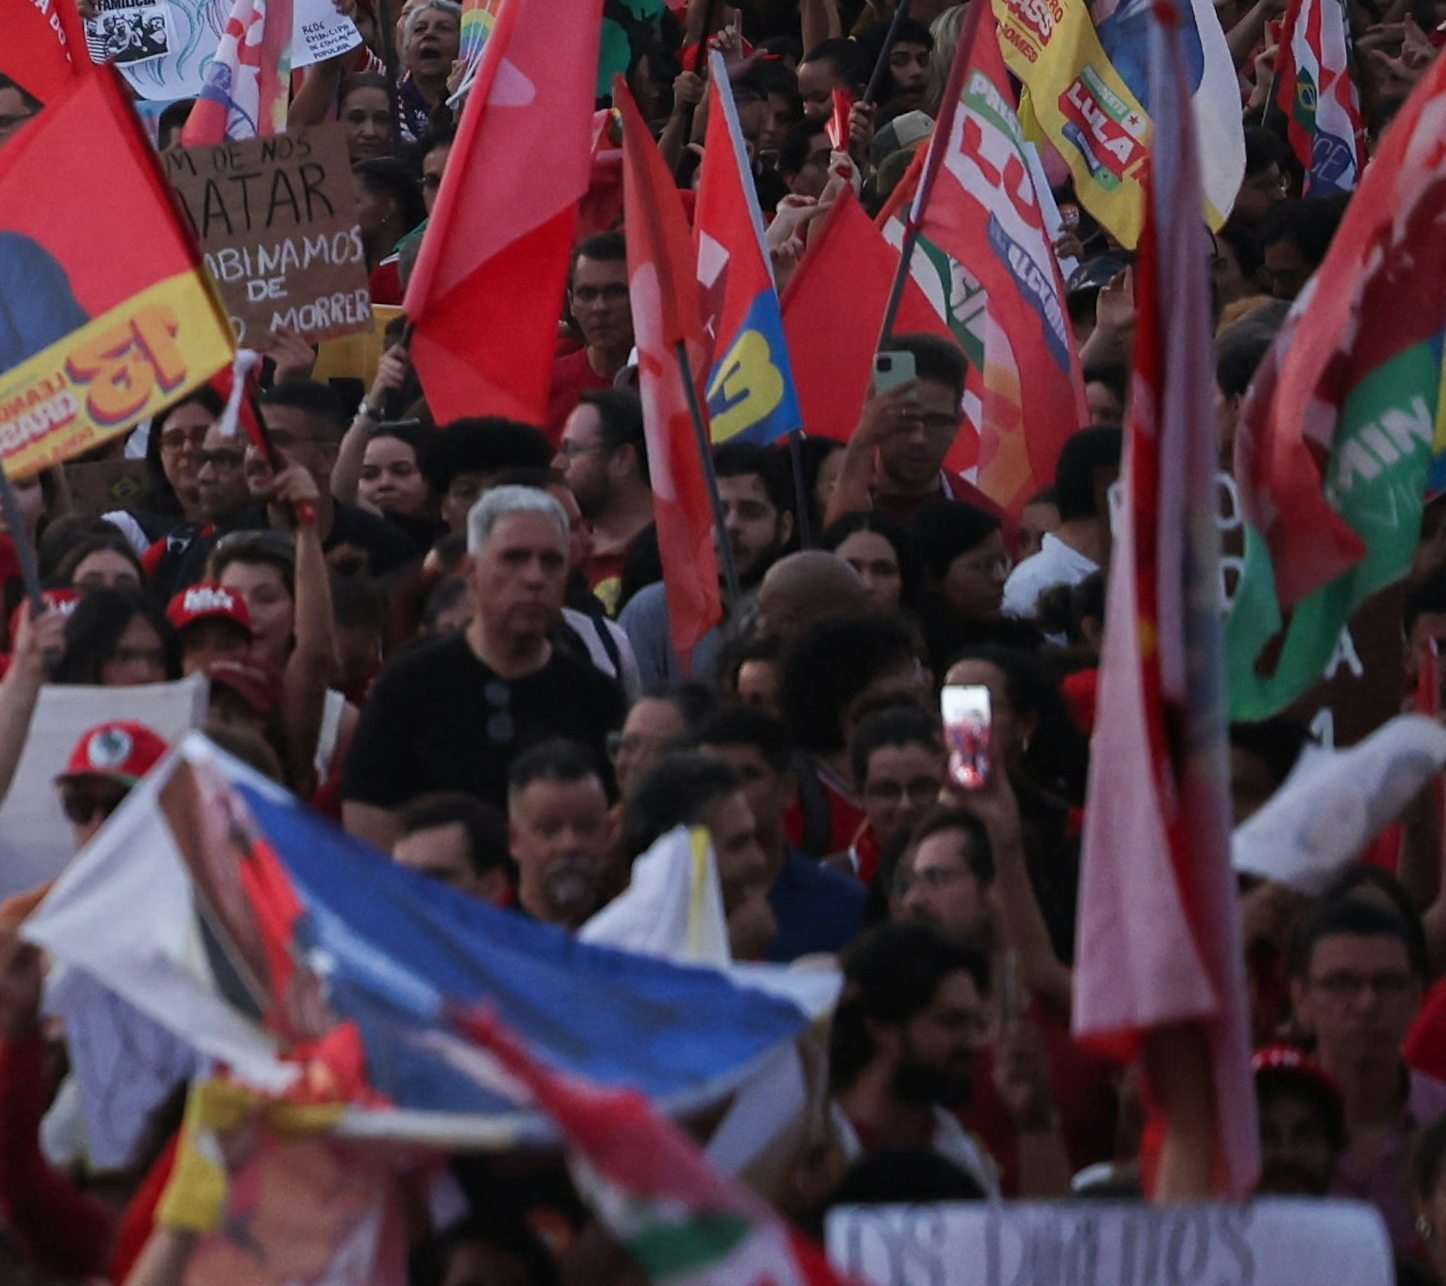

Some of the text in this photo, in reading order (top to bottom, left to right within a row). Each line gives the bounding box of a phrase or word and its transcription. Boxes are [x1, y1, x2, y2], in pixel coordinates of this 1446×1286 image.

[262, 137, 311, 163] NOS
[1067, 79, 1135, 164] LULA
[175, 161, 335, 240] ATAR
[960, 115, 1044, 229] LU
[247, 276, 288, 303] DE
[269, 288, 371, 334] MORRER
